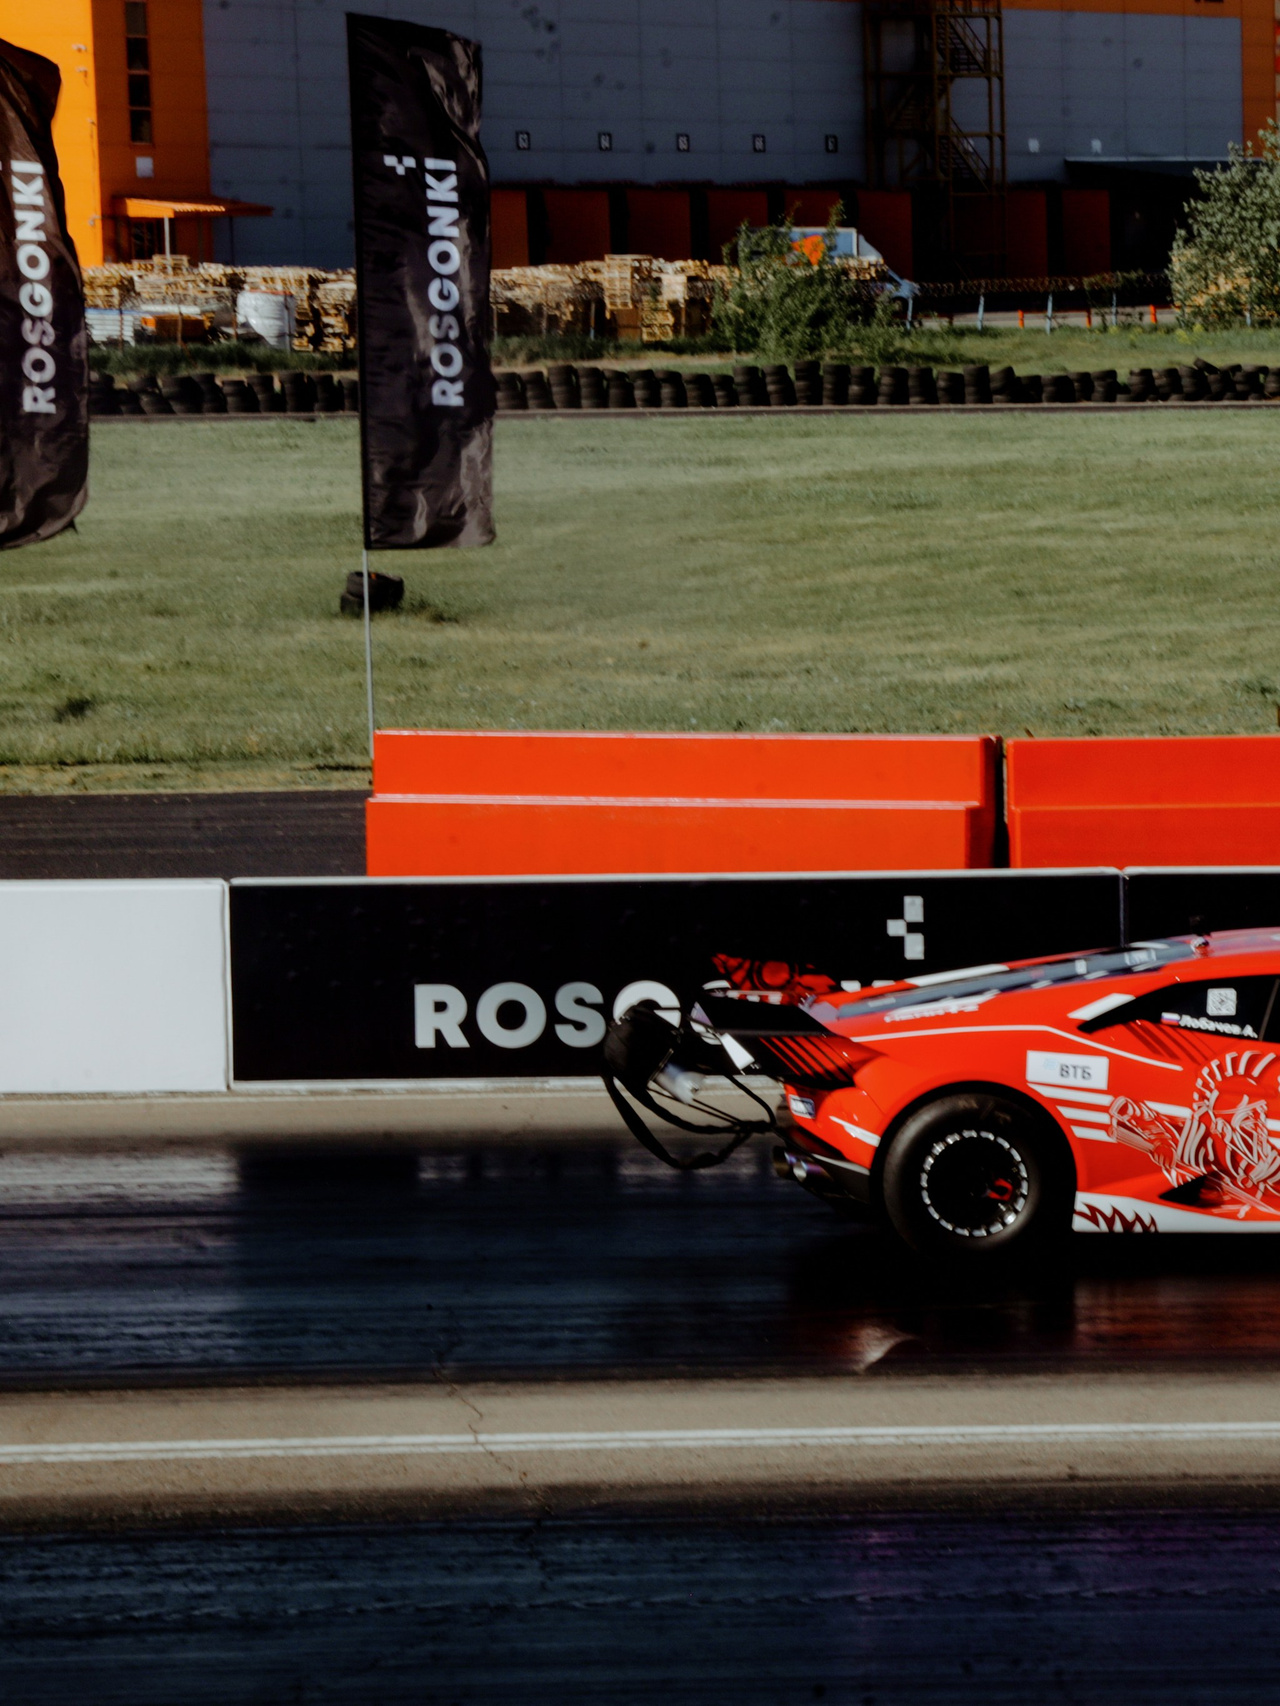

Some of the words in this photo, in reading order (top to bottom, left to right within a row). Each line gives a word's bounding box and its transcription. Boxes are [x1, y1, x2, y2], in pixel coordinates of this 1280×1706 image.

[10, 159, 57, 414] ROSGONKI
[424, 157, 465, 407] ROSGONKI
[1059, 1063, 1092, 1081] ВТБ
